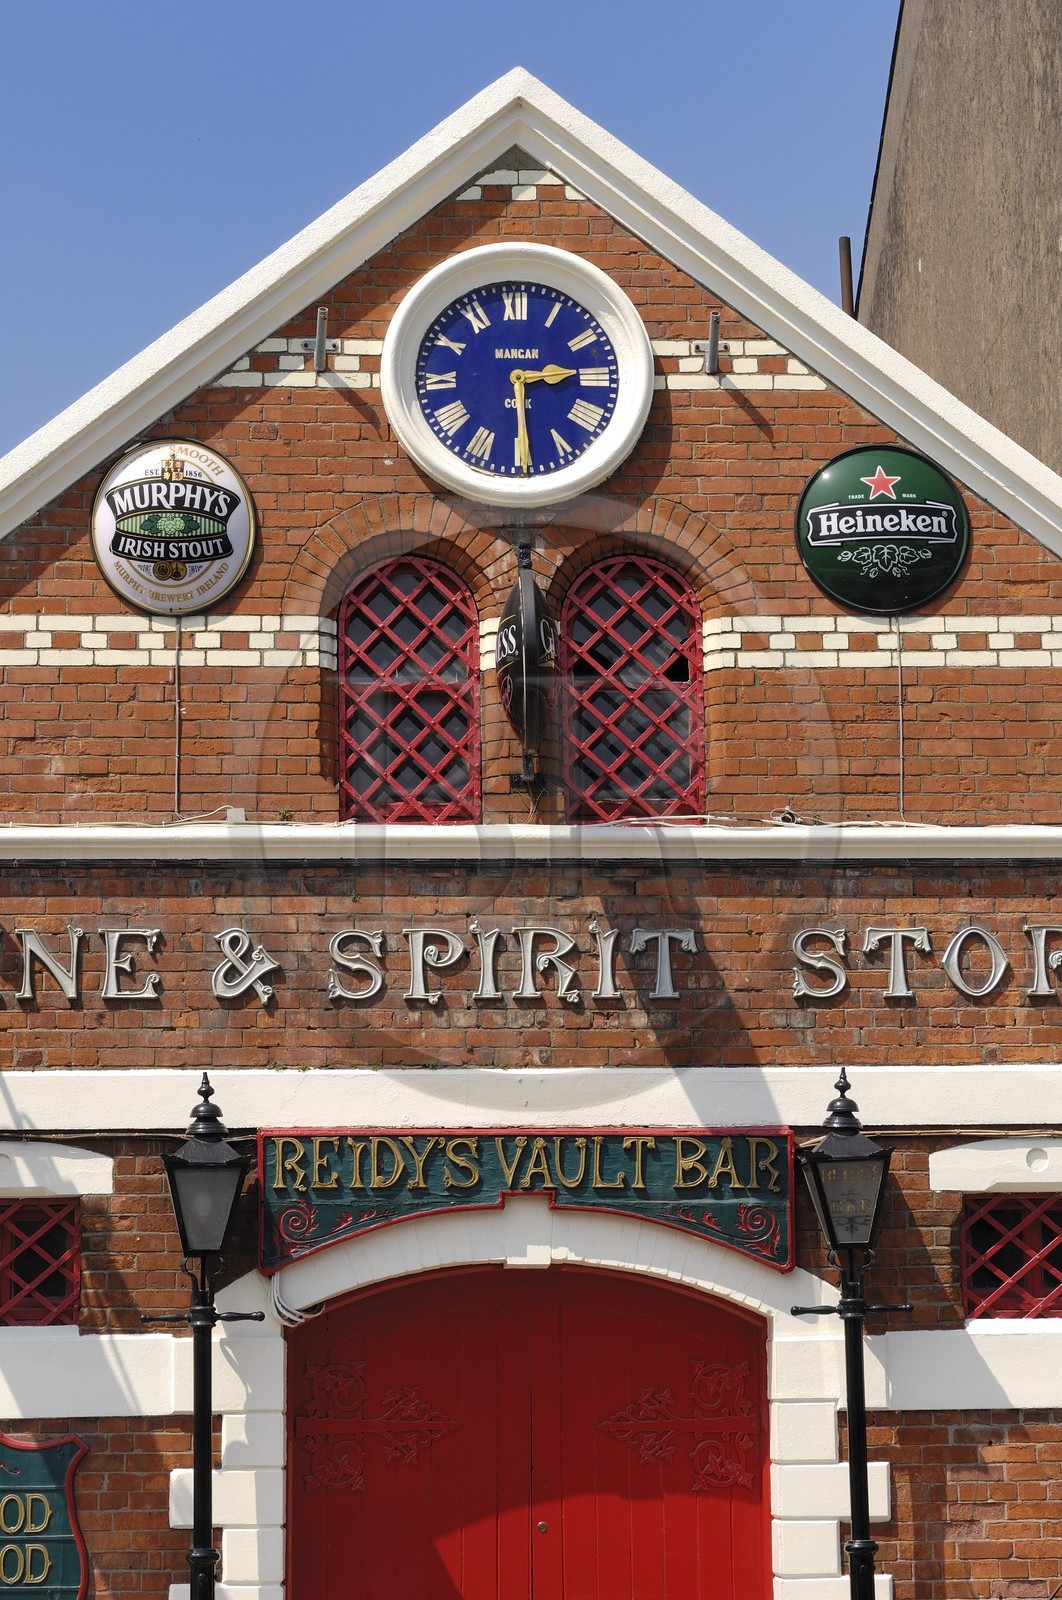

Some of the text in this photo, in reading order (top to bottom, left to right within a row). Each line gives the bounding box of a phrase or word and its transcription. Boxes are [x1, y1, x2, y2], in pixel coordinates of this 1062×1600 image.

[460, 300, 492, 335] XI
[502, 292, 528, 321] XII
[433, 332, 466, 356] X
[495, 348, 539, 360] MANGAN
[567, 328, 598, 352] II
[426, 370, 457, 391] IX
[579, 366, 610, 387] III
[433, 399, 470, 437] VIII
[504, 398, 532, 409] COK
[566, 398, 606, 433] IIII
[466, 426, 496, 461] VII
[168, 445, 225, 476] SMOOTH
[185, 470, 203, 478] 1856
[112, 482, 231, 516] MURPHY'S
[118, 536, 224, 559] IRISH STOUT
[113, 560, 230, 603] MURPHY BREWERY IRELAND
[213, 926, 281, 1006] &
[327, 919, 698, 1005] SPIRIT
[271, 1135, 783, 1193] REIDY'S VAULT BAR
